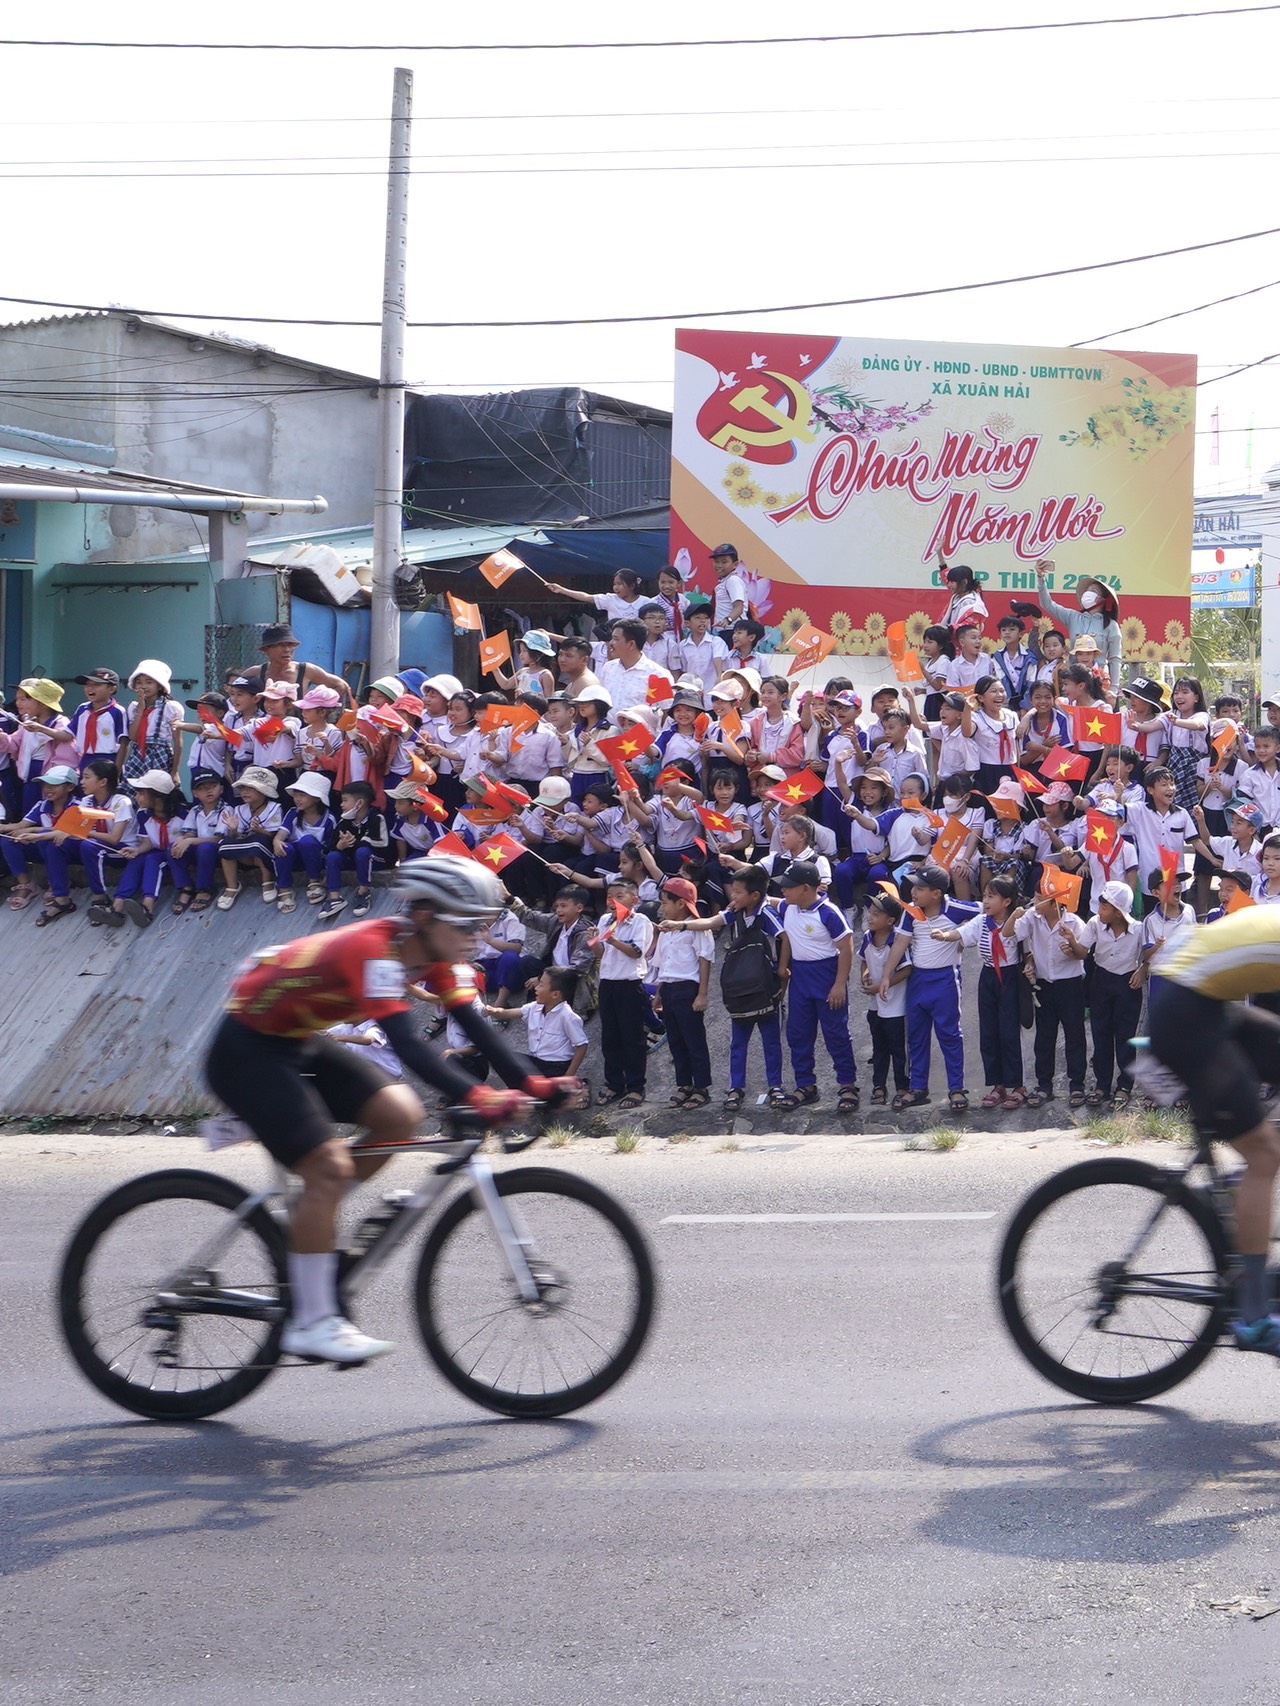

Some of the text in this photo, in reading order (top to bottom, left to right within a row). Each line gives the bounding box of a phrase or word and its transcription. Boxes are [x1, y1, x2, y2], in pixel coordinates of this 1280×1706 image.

[862, 353, 900, 371] ĐẢNG
[904, 355, 922, 372] ỦY
[934, 361, 970, 375] HĐND
[982, 363, 1019, 377] UBND
[1030, 366, 1102, 381] UBMTTQVN
[932, 379, 1030, 399] XÃ XUÂN HẢI
[765, 427, 1041, 524] Chúc Mừng
[923, 491, 1123, 560] Năm Mới
[931, 569, 989, 587] GP
